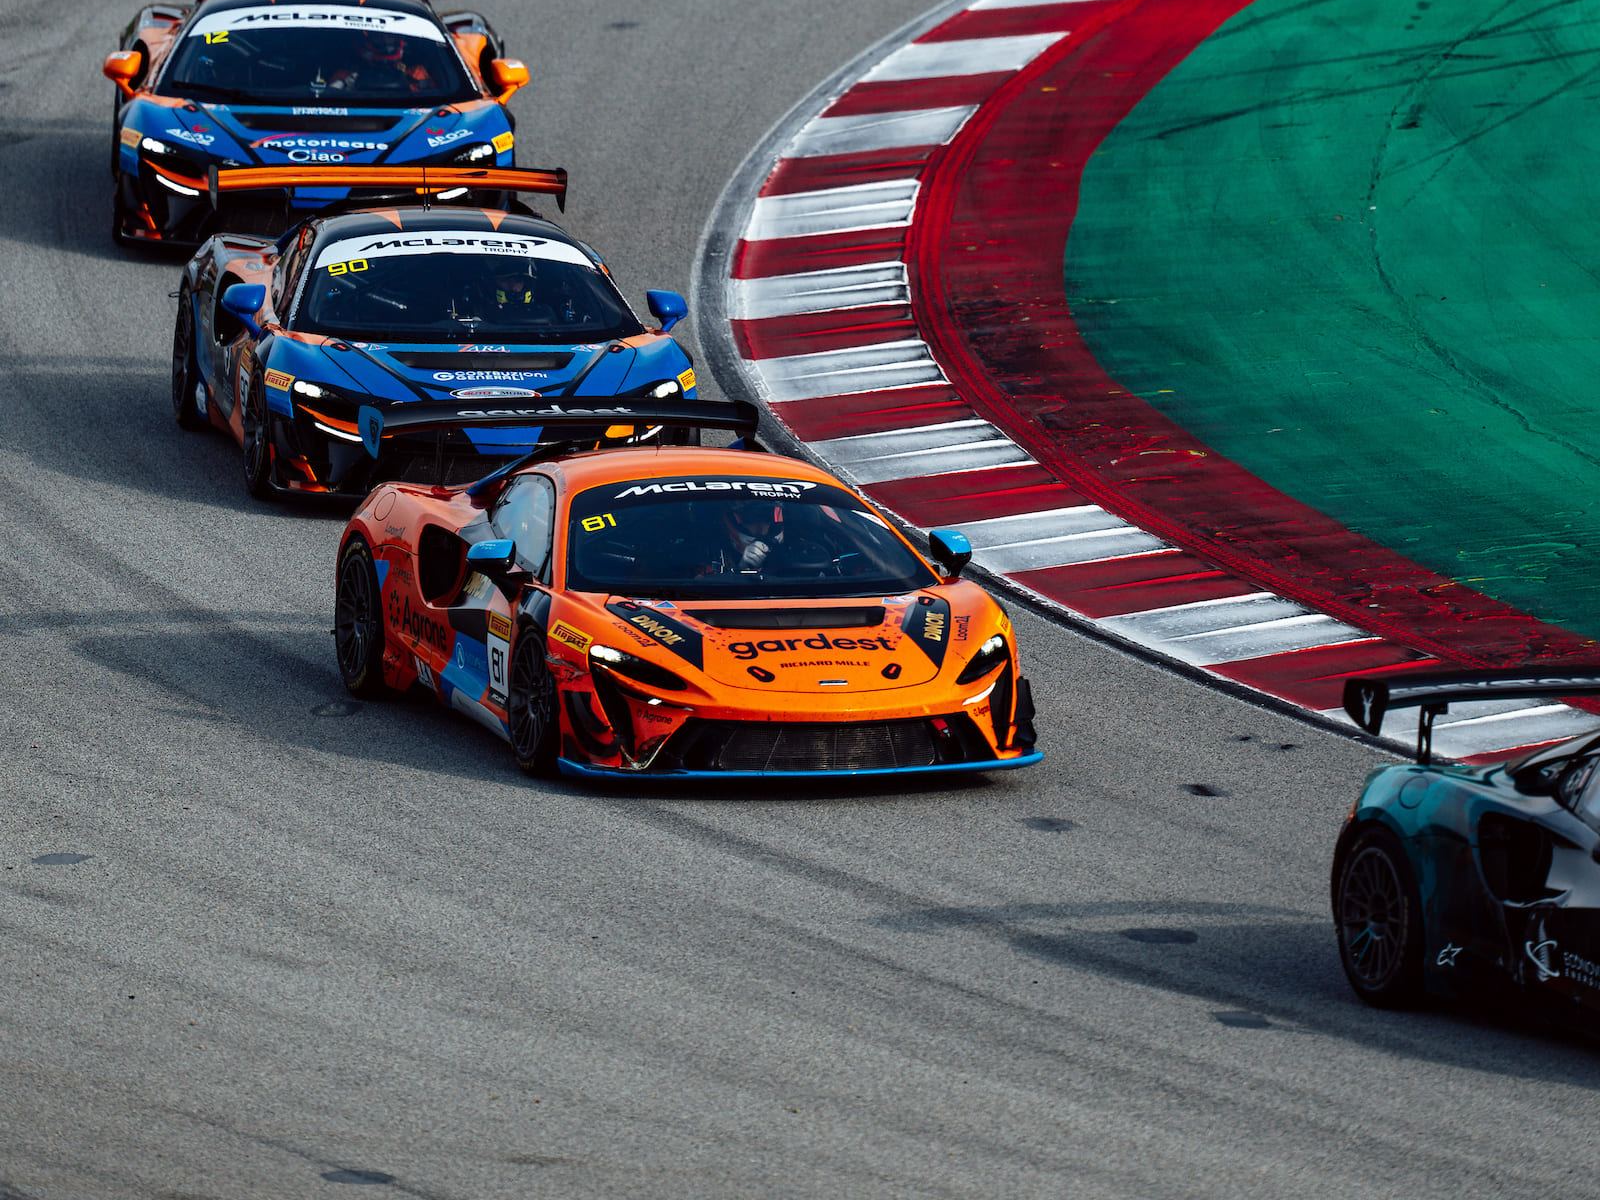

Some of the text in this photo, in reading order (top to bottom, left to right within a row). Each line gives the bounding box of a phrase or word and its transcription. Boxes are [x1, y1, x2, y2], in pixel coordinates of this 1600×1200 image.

[231, 13, 407, 25] McLaren
[204, 31, 229, 44] 12
[263, 138, 389, 150] motorlease
[288, 149, 344, 162] Ciao
[358, 238, 548, 252] McLaren
[482, 247, 529, 255] TROPHY
[328, 259, 369, 277] 90
[265, 371, 290, 388] PIRELLI
[614, 481, 817, 500] McLaren
[750, 490, 802, 500] TROPHY
[582, 513, 617, 532] 81
[401, 595, 447, 651] Agrone
[630, 614, 684, 645] DINOIL
[728, 633, 896, 660] gardest
[492, 647, 504, 686] 81
[780, 660, 871, 669] RICHARD MILLE
[642, 709, 673, 725] Agrone
